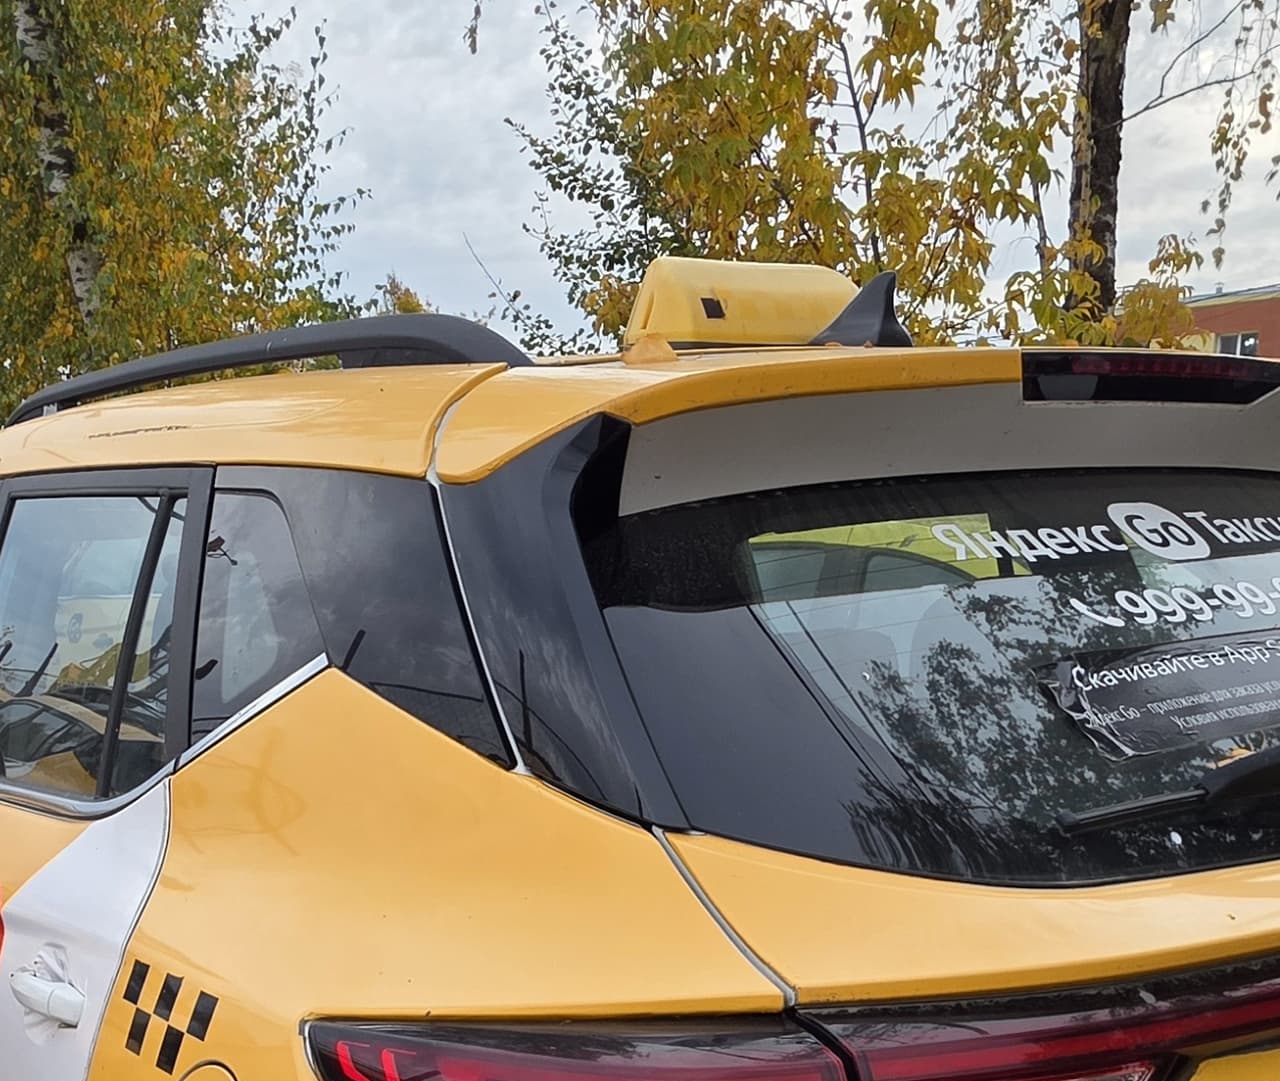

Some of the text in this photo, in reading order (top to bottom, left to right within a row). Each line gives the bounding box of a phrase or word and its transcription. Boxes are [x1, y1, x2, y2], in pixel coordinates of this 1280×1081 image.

[931, 523, 1129, 562] Яндекс
[1124, 514, 1196, 548] Go
[1072, 654, 1209, 691] Скачивайте
[1208, 652, 1225, 667] в
[1224, 645, 1270, 665] App
